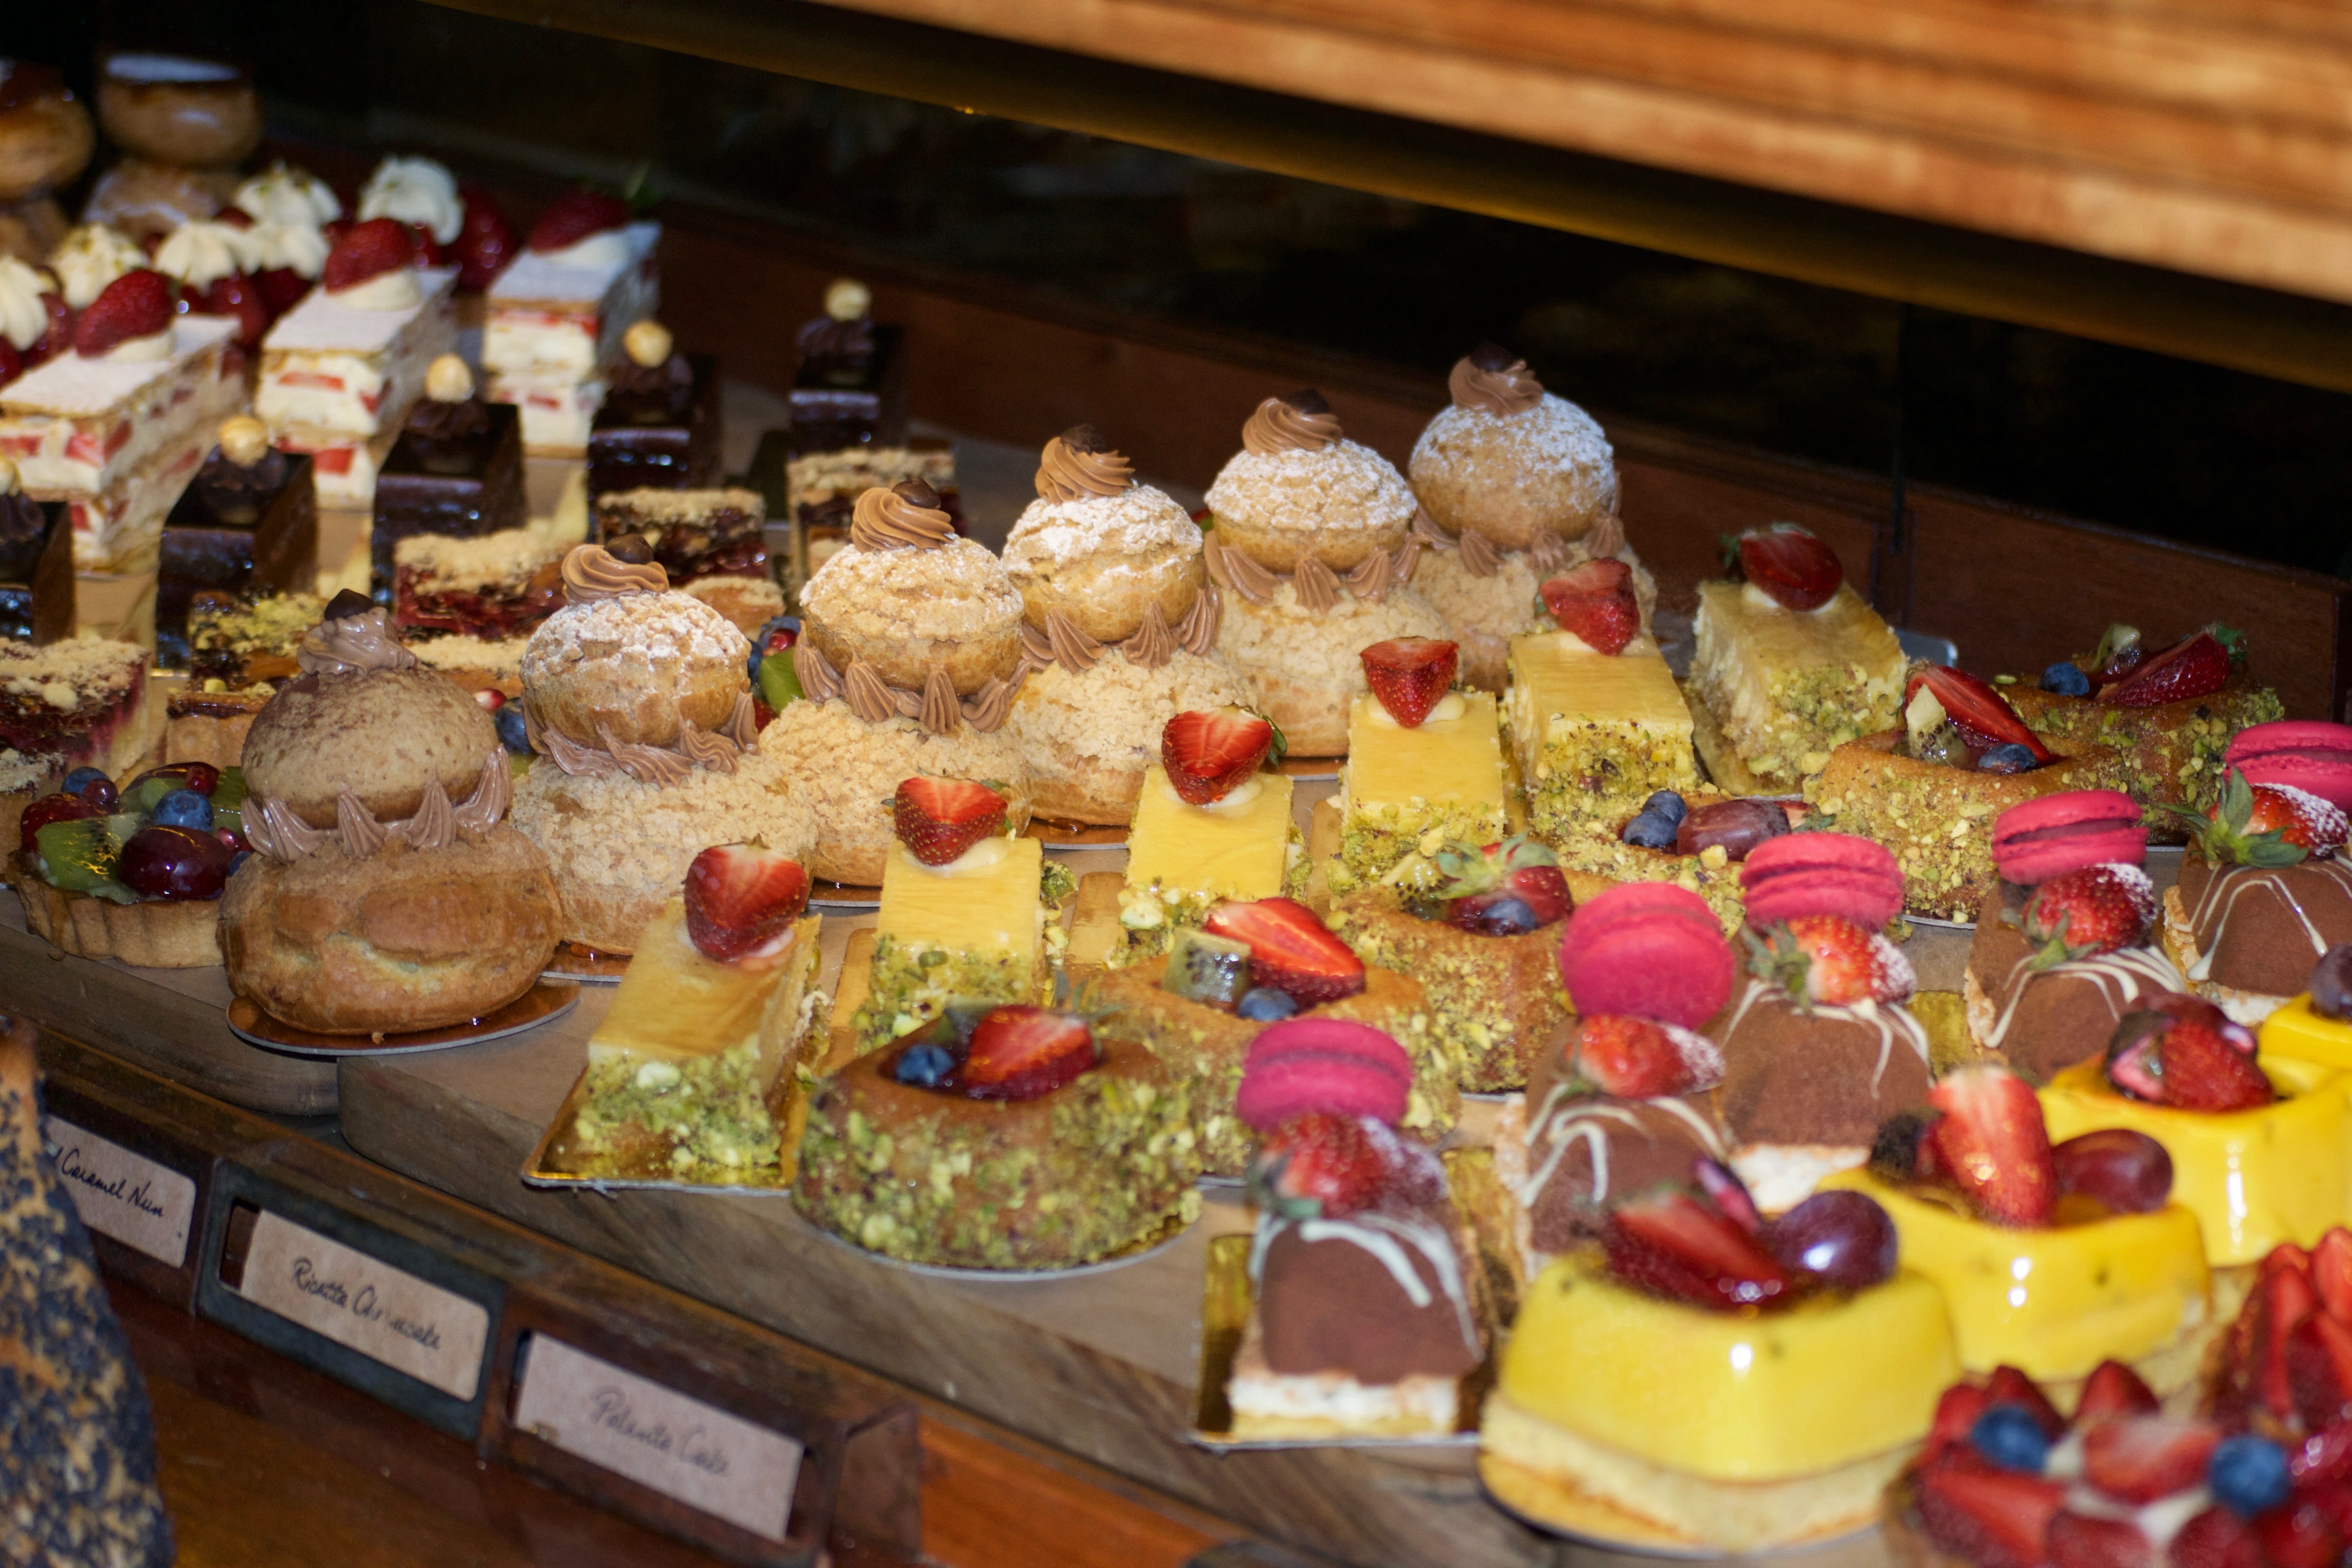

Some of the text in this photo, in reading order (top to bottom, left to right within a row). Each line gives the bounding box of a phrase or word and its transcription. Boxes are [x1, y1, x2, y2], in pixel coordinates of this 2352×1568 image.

[61, 1148, 163, 1217] Caramel Nun
[291, 1257, 348, 1308] Ricotta
[590, 1385, 673, 1451] Polenta
